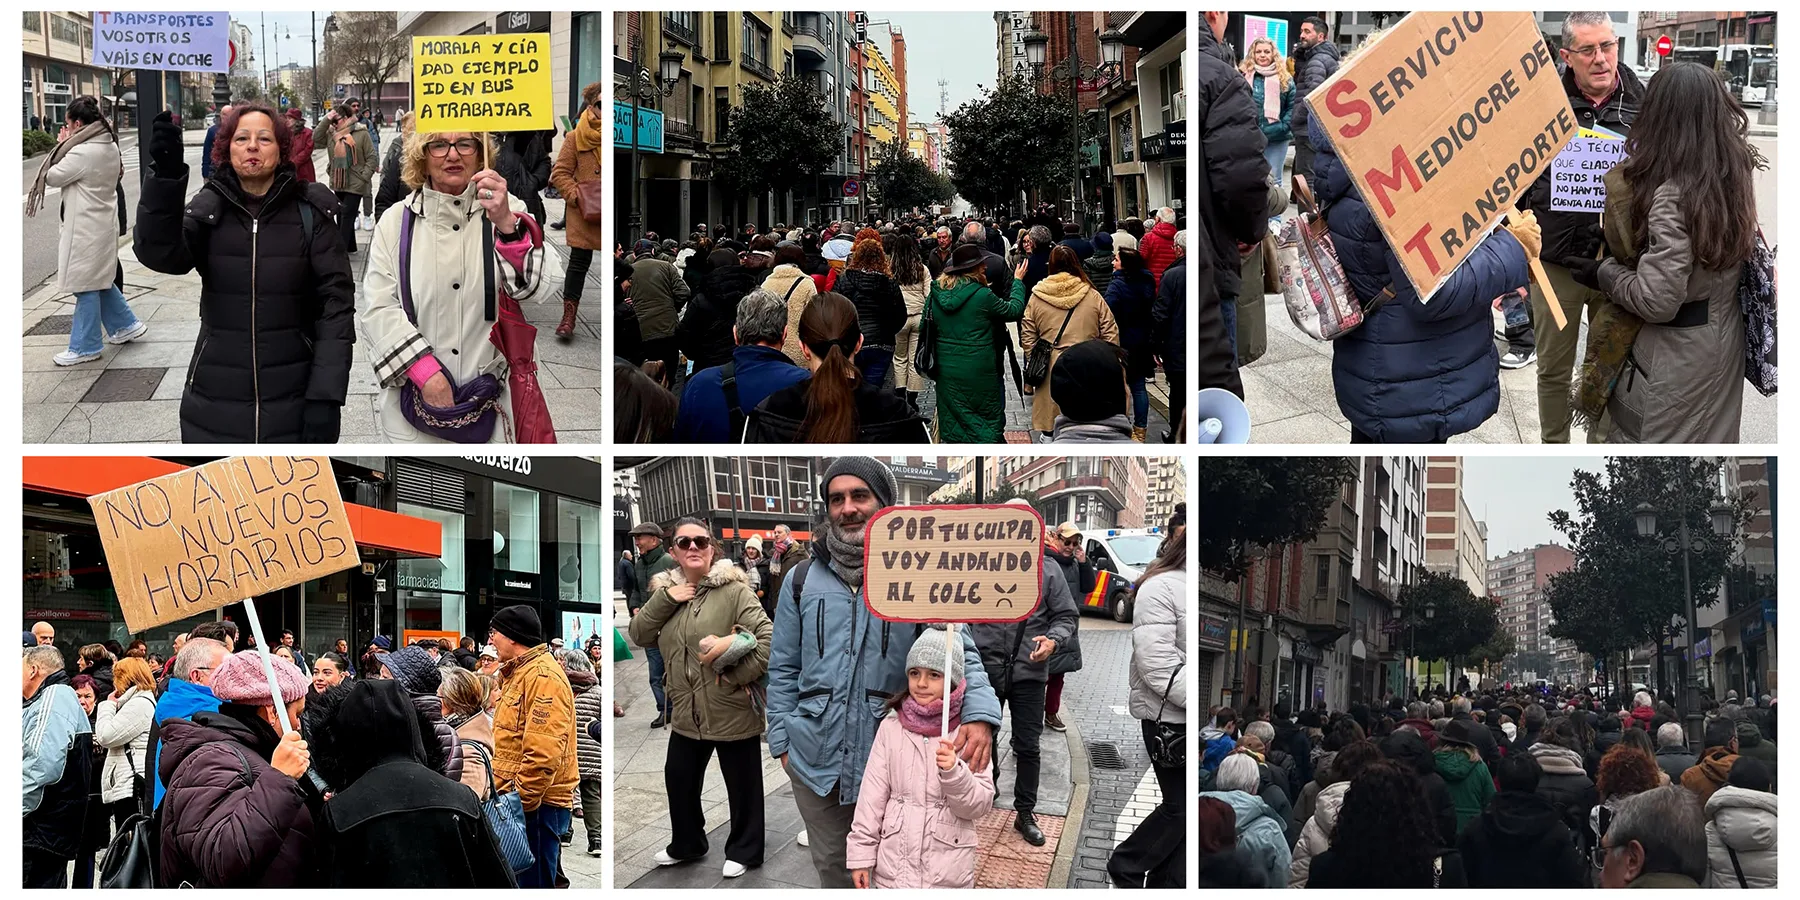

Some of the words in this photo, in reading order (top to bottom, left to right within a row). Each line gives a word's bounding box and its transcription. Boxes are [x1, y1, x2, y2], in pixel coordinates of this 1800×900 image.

[98, 11, 214, 28] TRANSPORTES
[101, 30, 191, 44] VOSOTROS
[421, 41, 481, 56] MORALA
[143, 52, 163, 65] EN
[168, 52, 213, 67] COCHE
[421, 63, 454, 77] DAD
[462, 59, 539, 76] EJEMPLO
[1325, 11, 1484, 138] SERVICIO
[423, 82, 445, 95] ID
[450, 81, 475, 96] EN
[481, 78, 514, 95] BUS
[420, 103, 432, 119] A
[437, 102, 532, 119] TRABAJAR
[1364, 69, 1520, 219] MEDIOCRE
[1519, 39, 1551, 80] DE
[1562, 142, 1582, 153] OS
[1554, 158, 1575, 168] QUE
[1556, 171, 1588, 182] ESTOS
[1403, 106, 1573, 277] TRANSPORTE
[1556, 185, 1569, 193] NO
[1571, 186, 1592, 195] HAN
[1552, 197, 1582, 207] CUENTA
[890, 465, 934, 476] VALDERRAMA
[105, 482, 172, 539] NO
[193, 471, 226, 514] A
[243, 456, 320, 494] LOS
[181, 484, 329, 559] NUEVOS
[887, 516, 936, 541] POR
[938, 522, 969, 543] TU
[974, 519, 1037, 544] CULPA,
[143, 520, 346, 616] HORARIOS
[881, 550, 931, 571] VOY
[936, 550, 1032, 572] ANDANDO
[886, 581, 915, 604] AL
[929, 581, 982, 604] COLE
